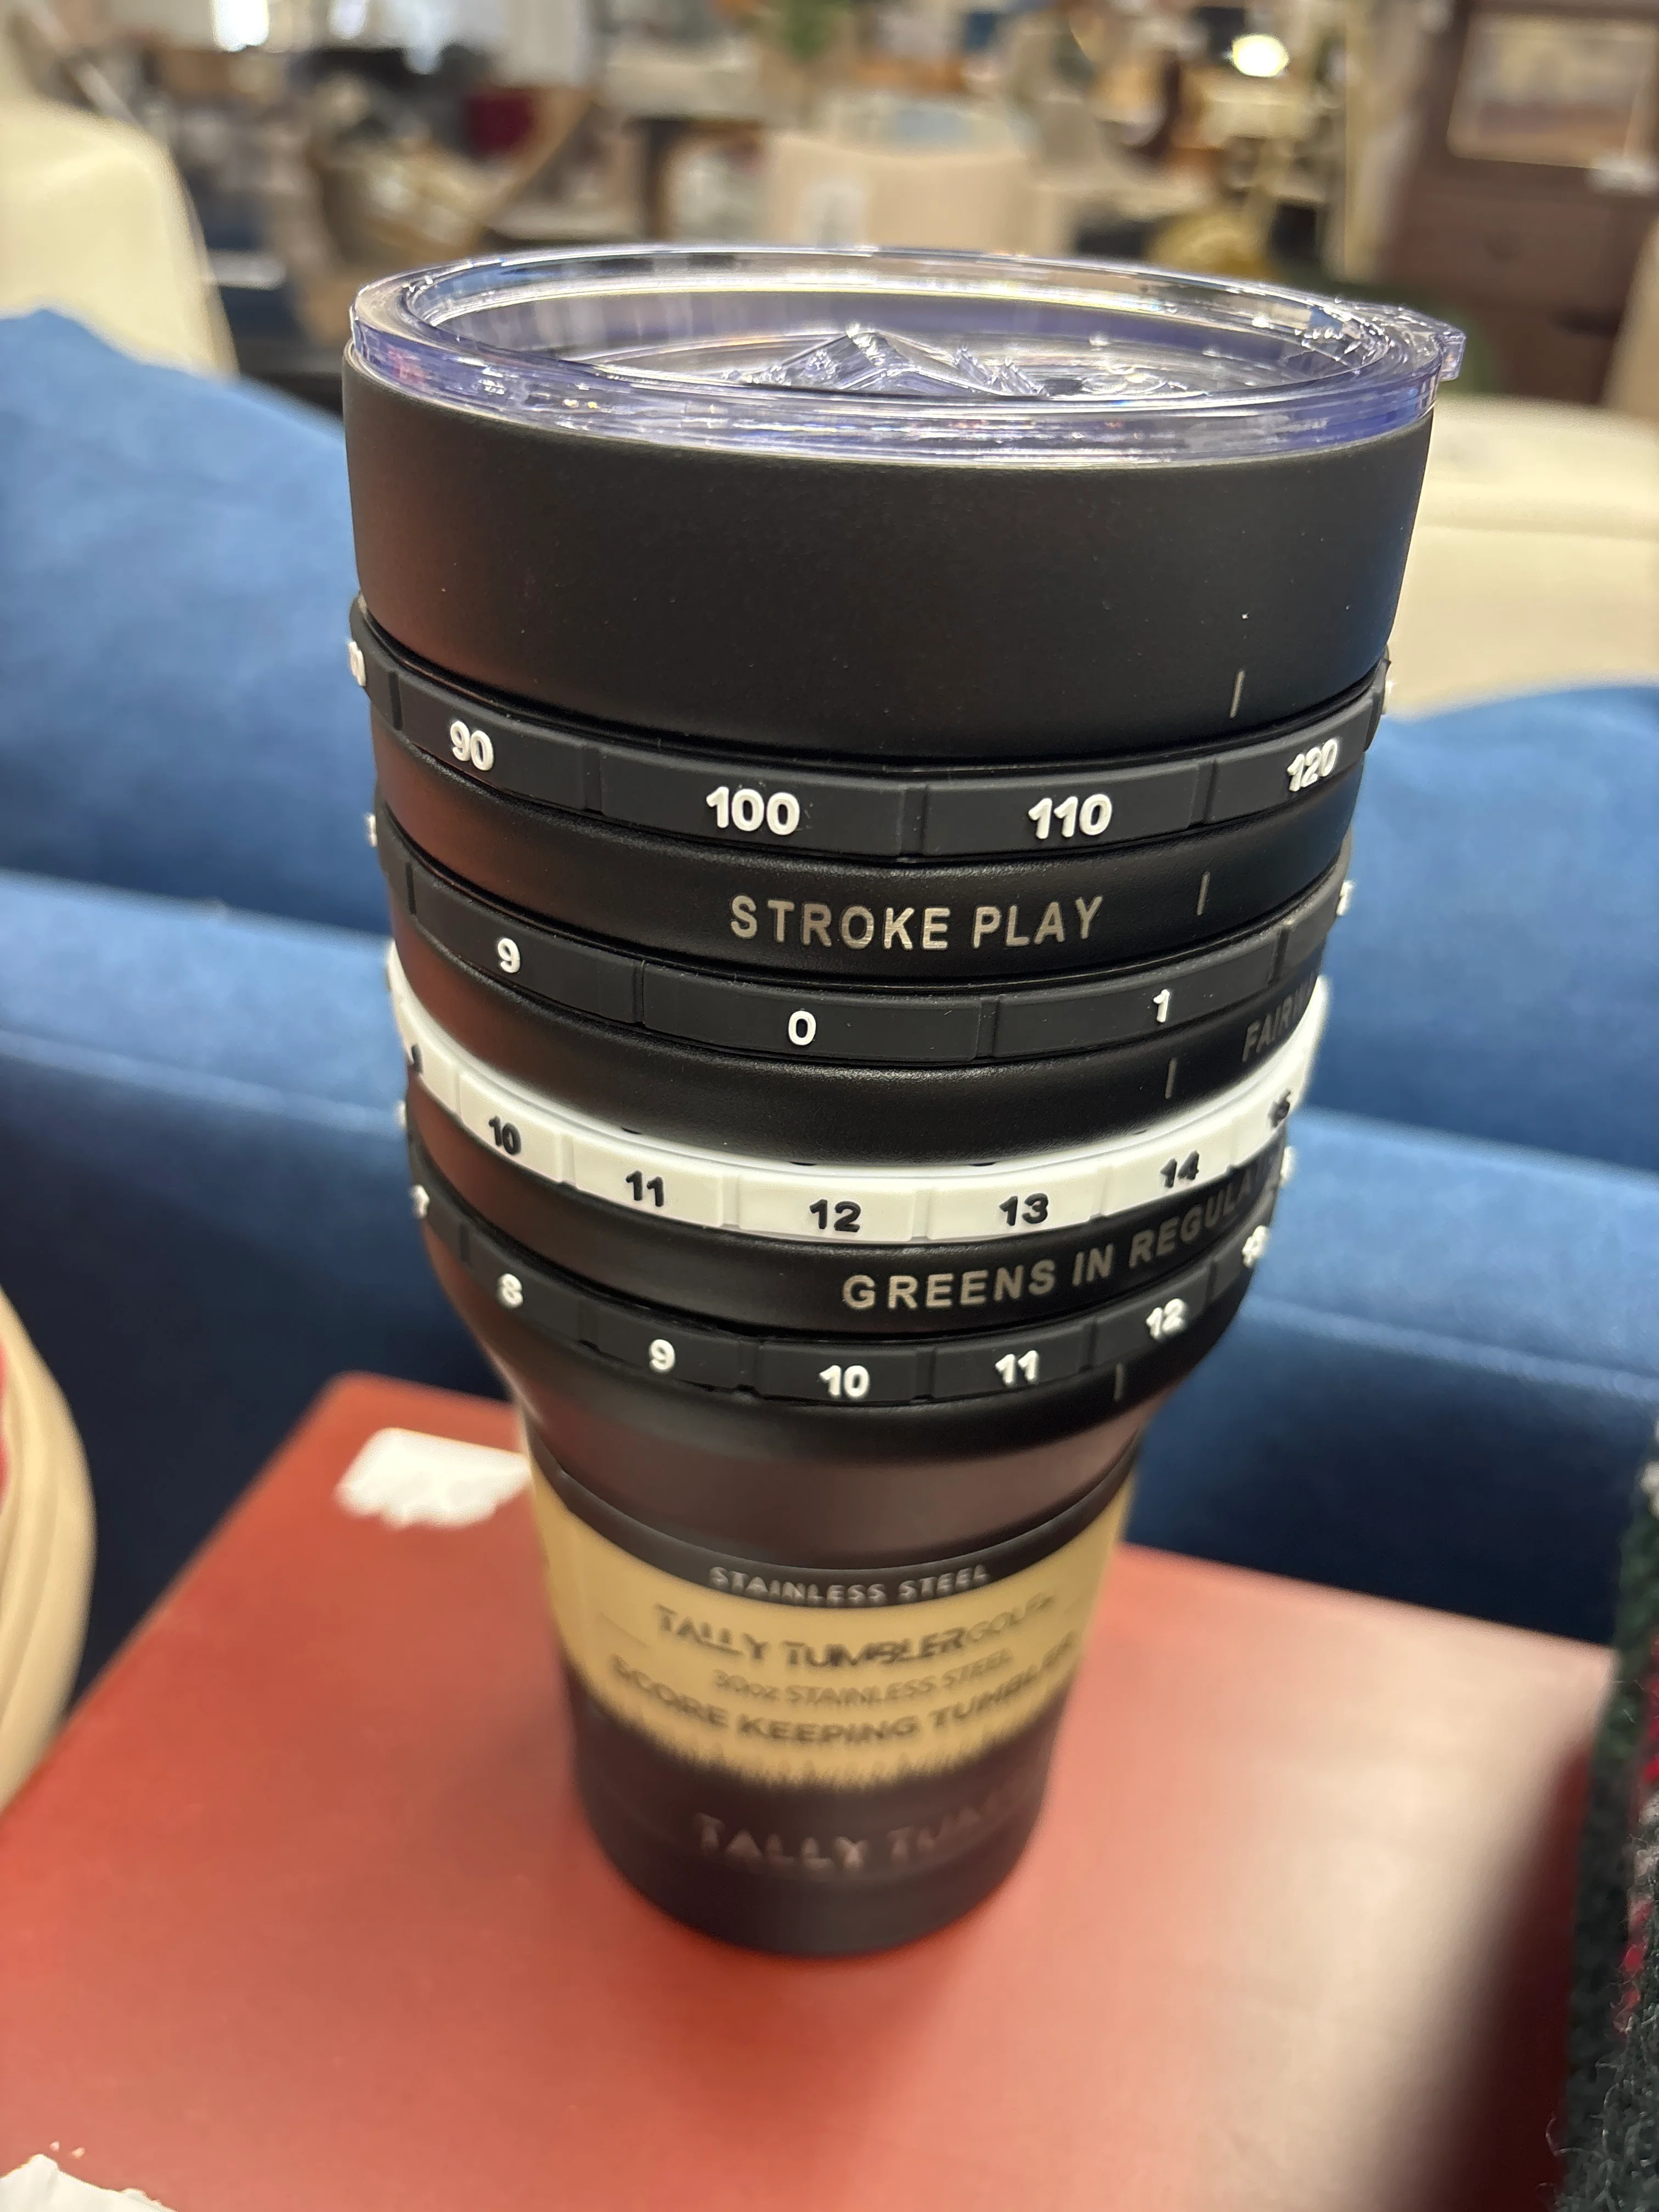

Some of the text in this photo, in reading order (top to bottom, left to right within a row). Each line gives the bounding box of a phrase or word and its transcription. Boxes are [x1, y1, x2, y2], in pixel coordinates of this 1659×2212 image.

[450, 720, 494, 770] 90
[706, 786, 800, 836] 100
[1028, 794, 1112, 839] 110
[1286, 739, 1339, 792] 120
[730, 895, 1102, 951] STROKE PLAY
[497, 938, 1170, 1046] 9 0 1
[488, 1116, 522, 1155] 10
[625, 1170, 665, 1207] 11
[809, 1198, 861, 1233] 12
[999, 1192, 1049, 1227] 13
[1160, 1150, 1200, 1188] 14
[842, 1260, 1057, 1310] GREENS
[1072, 1243, 1114, 1286] IN
[496, 1273, 524, 1310] 8
[648, 1338, 676, 1374] 9
[819, 1364, 871, 1399] 10
[995, 1350, 1040, 1384] 11
[1146, 1297, 1187, 1340] 12
[709, 1564, 990, 1607] STAINLESS STEEL
[654, 1603, 769, 1661] TALLY
[608, 1654, 729, 1729] SCORE
[737, 1714, 921, 1746] KEEPING
[785, 1675, 936, 1706] STAINLESS
[941, 1647, 1013, 1690] STEEL
[692, 1812, 870, 1869] TALLY
